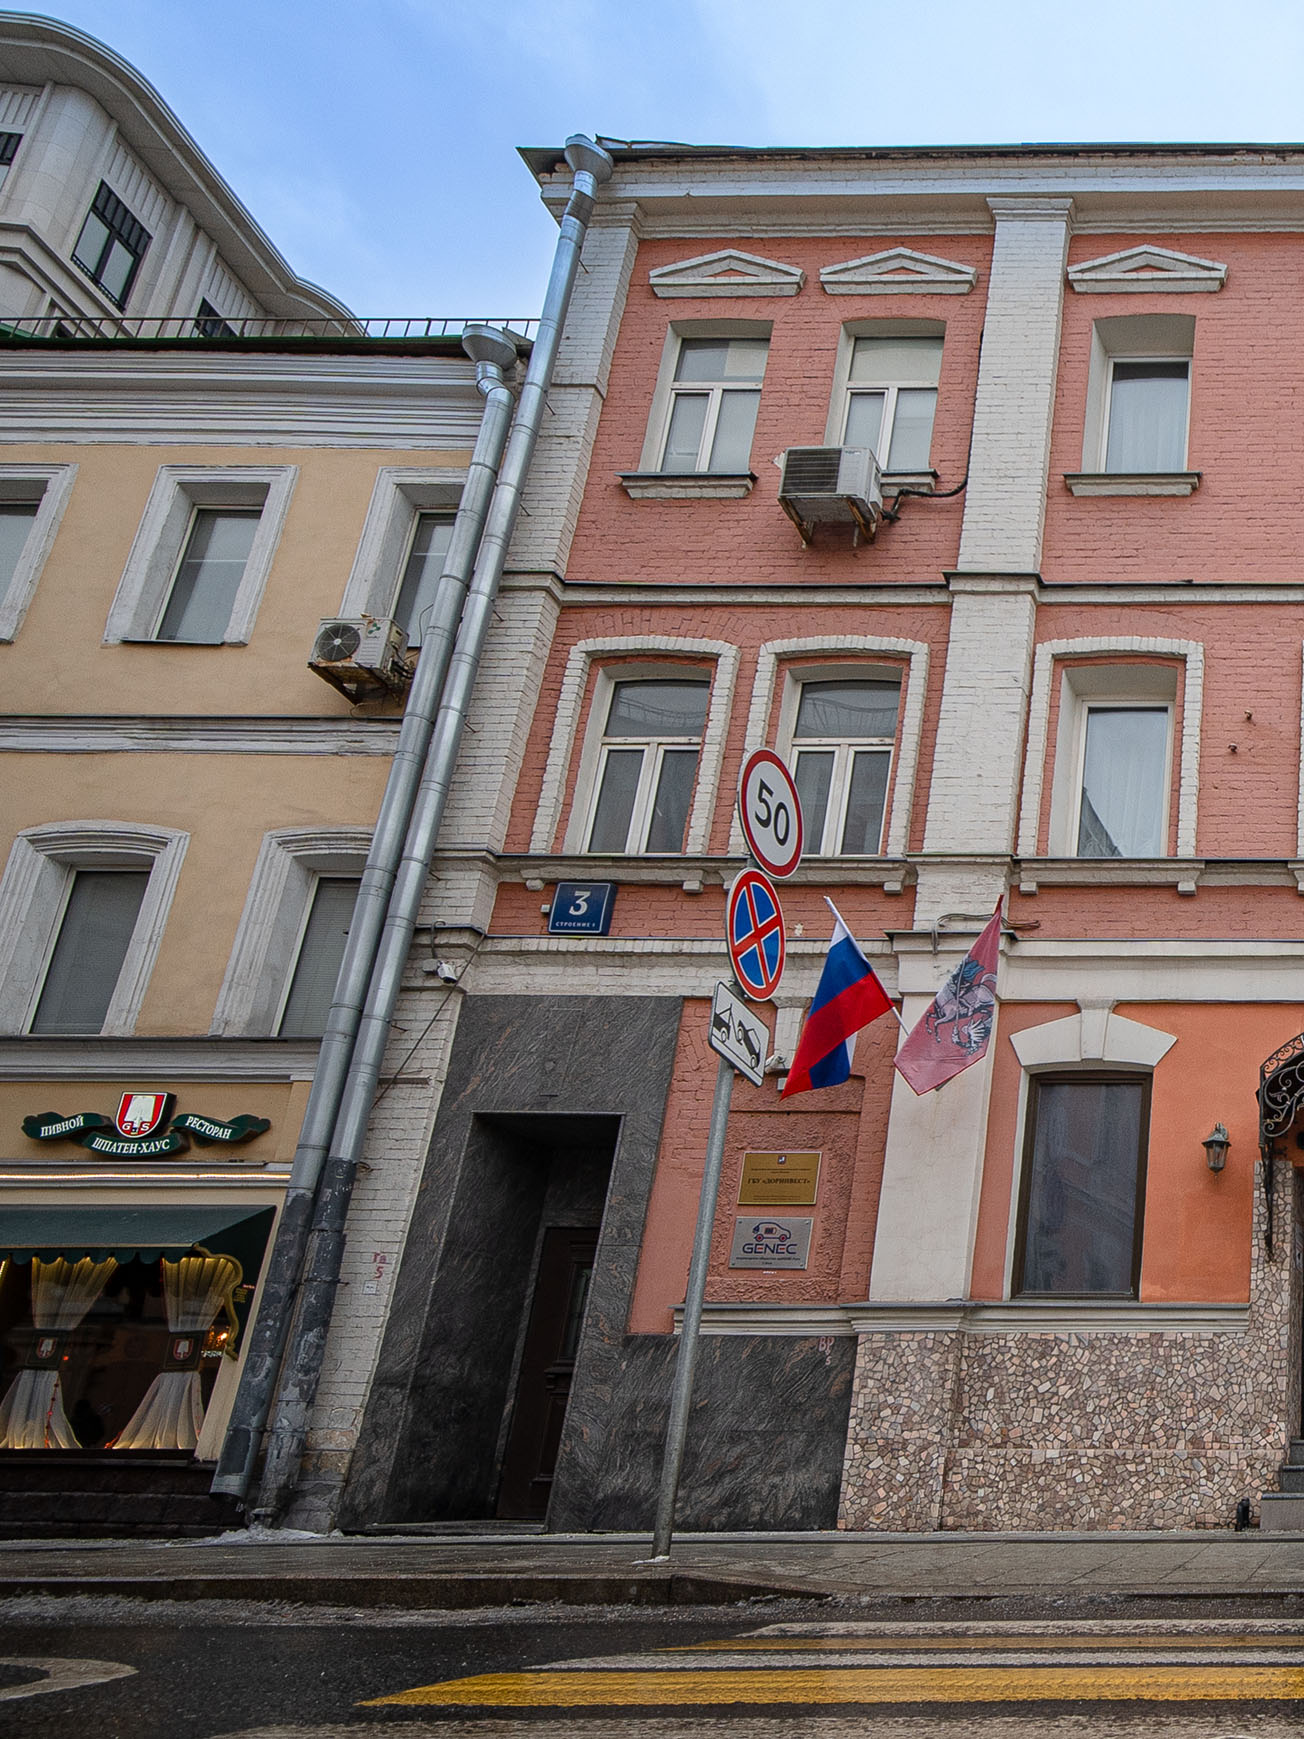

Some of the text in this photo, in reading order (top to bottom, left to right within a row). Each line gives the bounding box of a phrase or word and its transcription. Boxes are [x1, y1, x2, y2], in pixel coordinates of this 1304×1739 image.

[755, 778, 790, 846] 50
[568, 890, 592, 916] 3
[40, 1115, 84, 1137] ПИВНОЙ
[185, 1116, 232, 1139] РЕСТОРАН
[742, 1243, 798, 1255] GENEC
